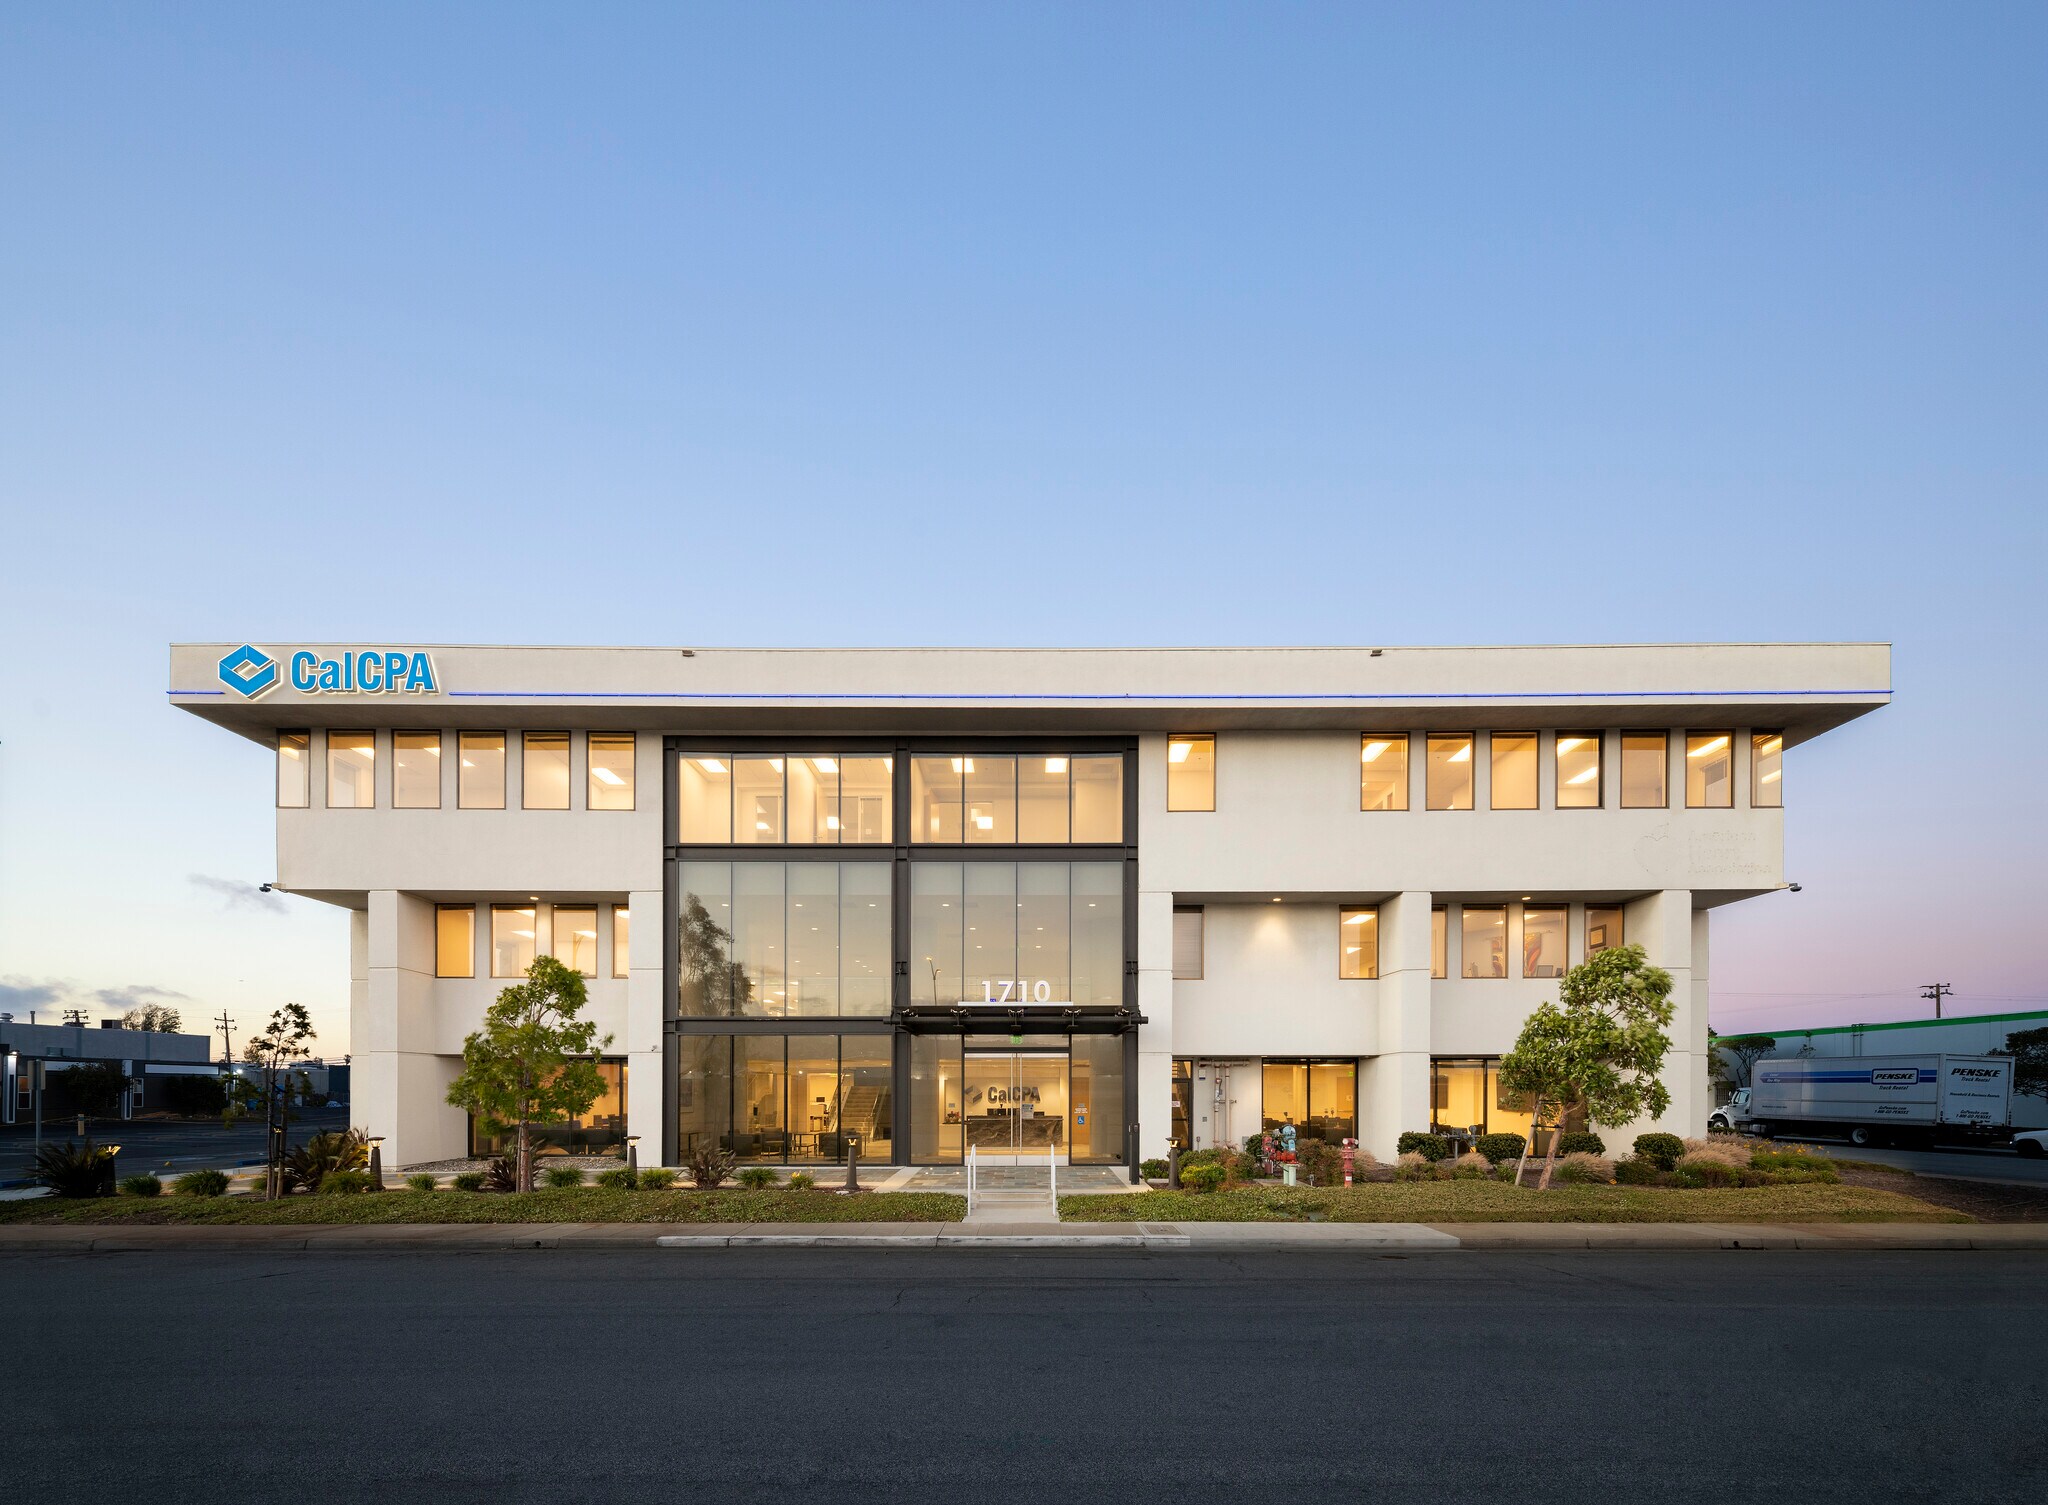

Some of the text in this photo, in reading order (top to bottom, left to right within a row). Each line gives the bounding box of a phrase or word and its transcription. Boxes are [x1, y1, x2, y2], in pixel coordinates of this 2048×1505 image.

[291, 650, 437, 692] CalCPA
[981, 980, 1051, 1003] 1710
[1951, 1068, 2002, 1078] PENSKE
[987, 1086, 1041, 1104] CalCPA
